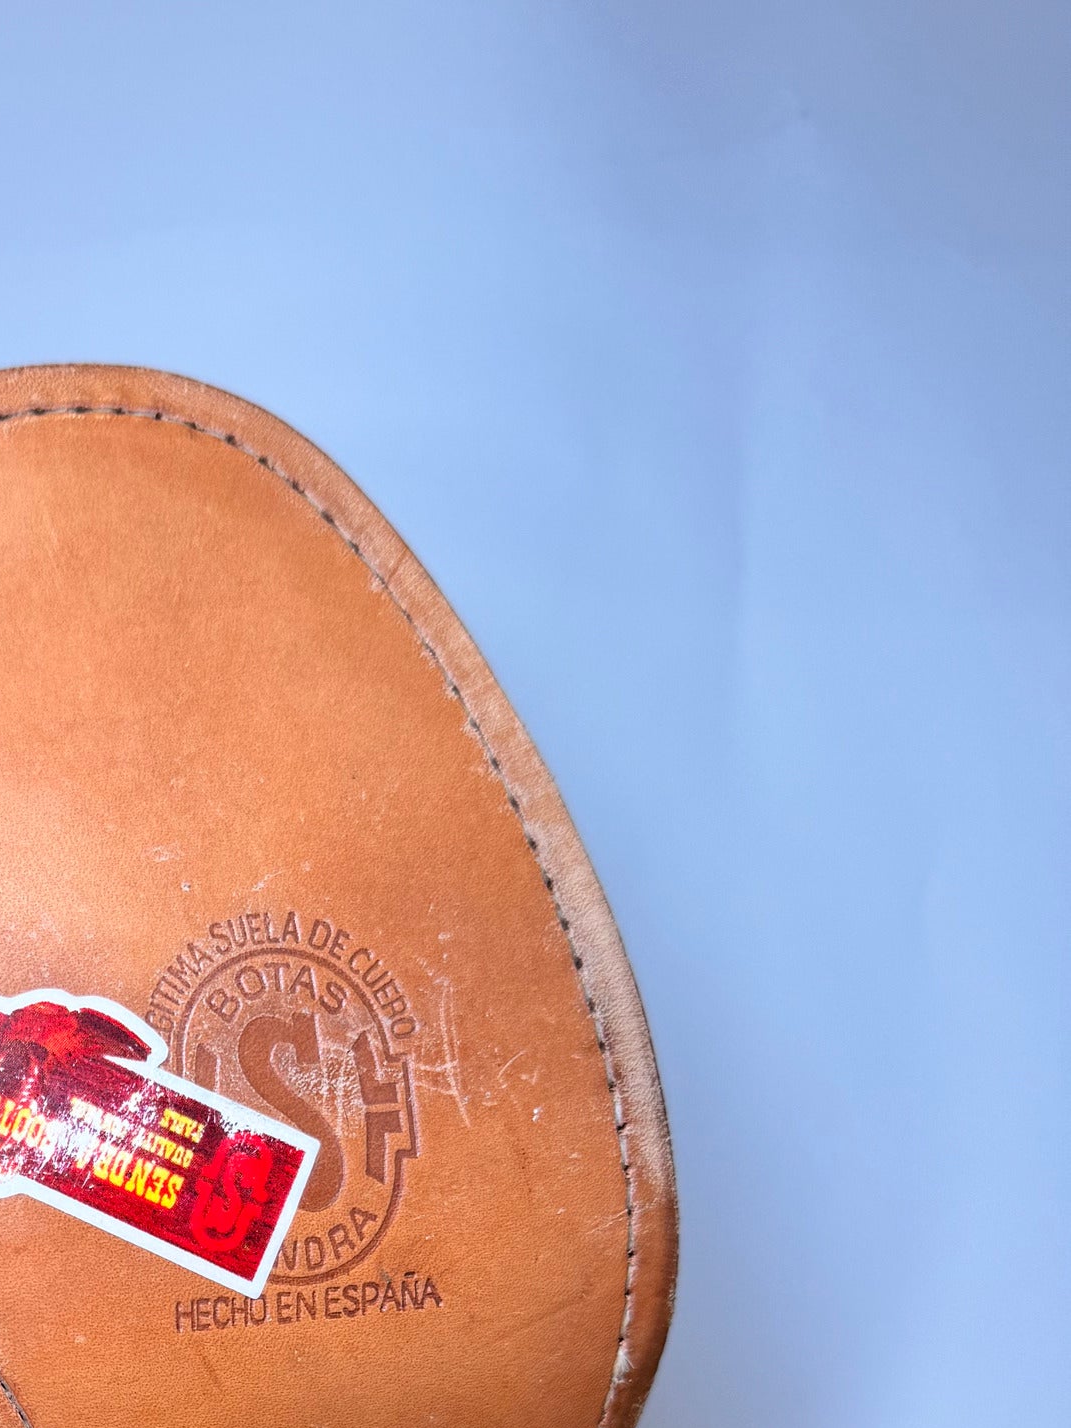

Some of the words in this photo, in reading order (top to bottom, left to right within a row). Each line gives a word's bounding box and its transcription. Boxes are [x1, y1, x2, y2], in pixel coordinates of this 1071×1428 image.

[144, 941, 212, 1034] GITIMA
[209, 911, 302, 953] SUELA
[308, 918, 351, 960] DE
[349, 947, 419, 1041] CUERO
[206, 962, 348, 1023] BOTAS
[74, 1136, 185, 1210] SENDRA
[272, 1206, 379, 1272] NDRA
[175, 1295, 269, 1333] HECHO
[276, 1290, 317, 1325] EN
[324, 1271, 443, 1320] ESPAÑA
